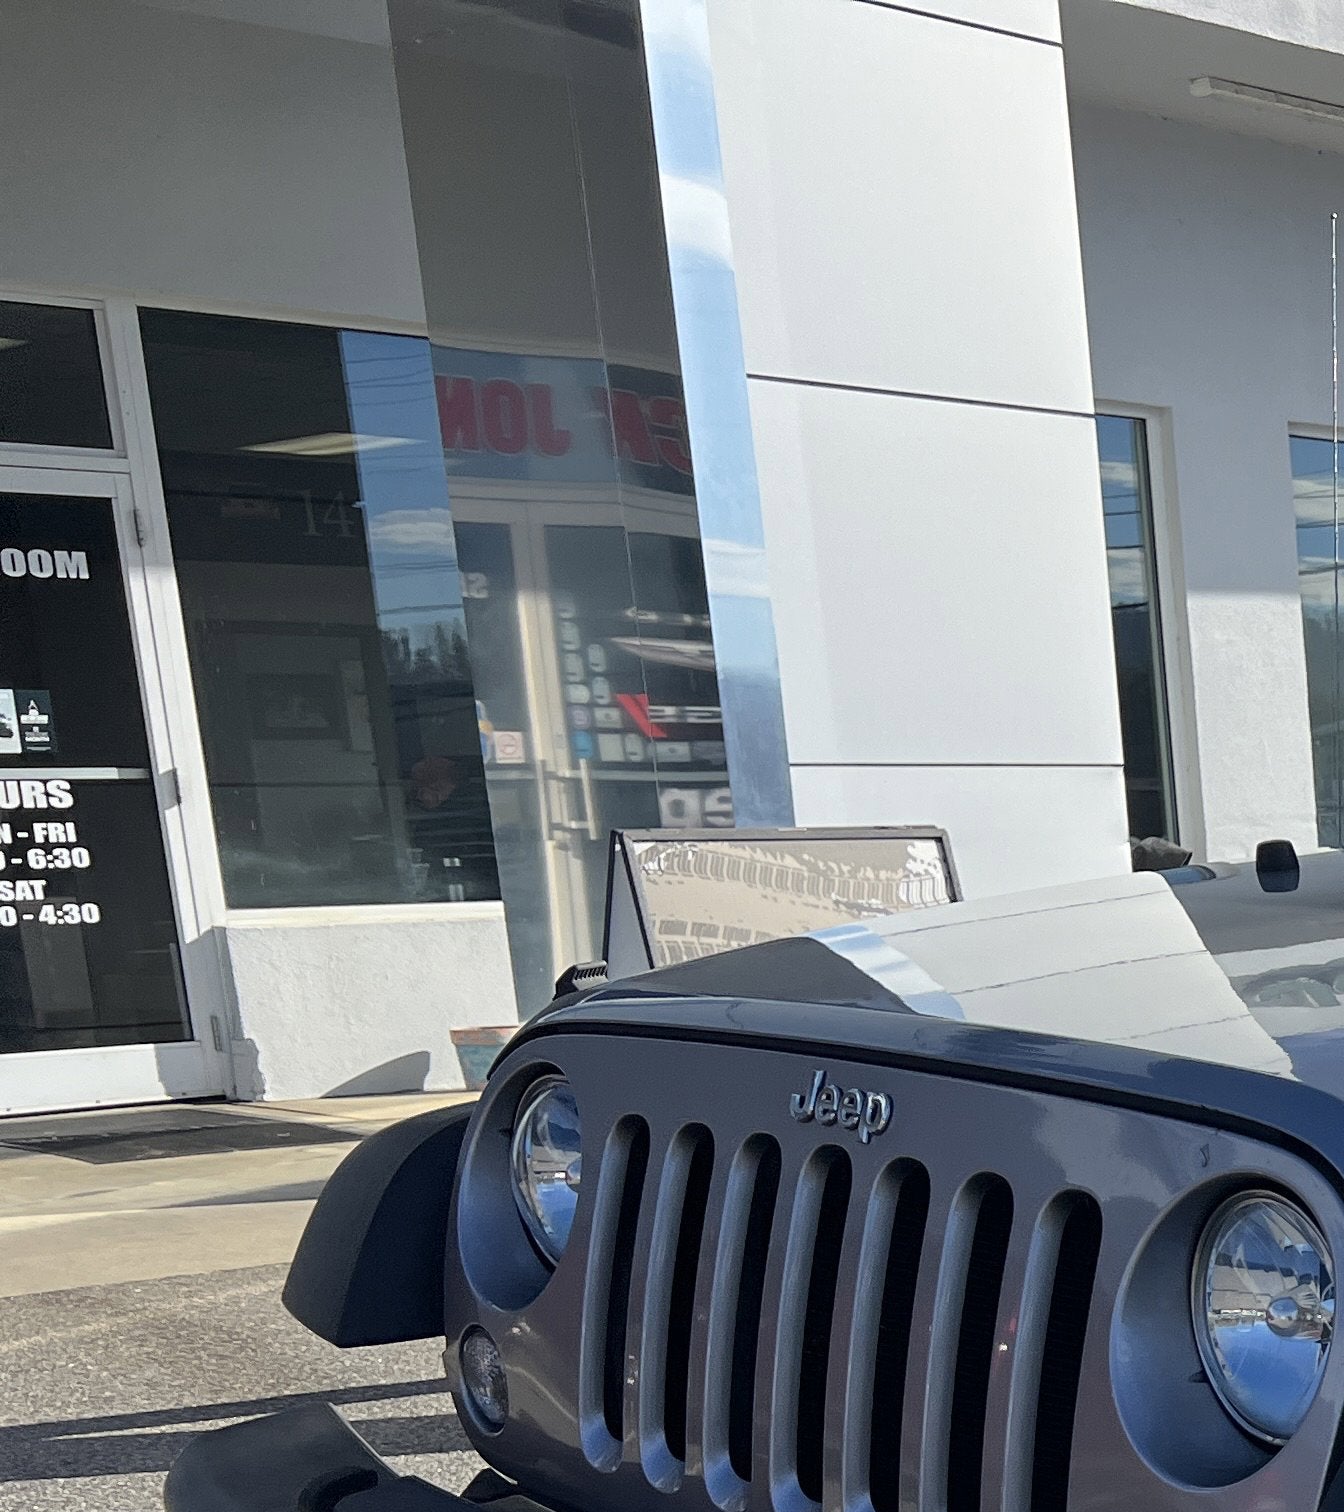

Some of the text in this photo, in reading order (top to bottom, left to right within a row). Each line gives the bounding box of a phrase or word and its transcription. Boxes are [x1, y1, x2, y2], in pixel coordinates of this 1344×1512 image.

[0, 547, 90, 580] OOM
[32, 822, 78, 844] FRI
[26, 846, 91, 870] 6:30
[0, 879, 47, 901] SAT
[38, 902, 101, 926] 4:30
[790, 1069, 894, 1144] Jeep
